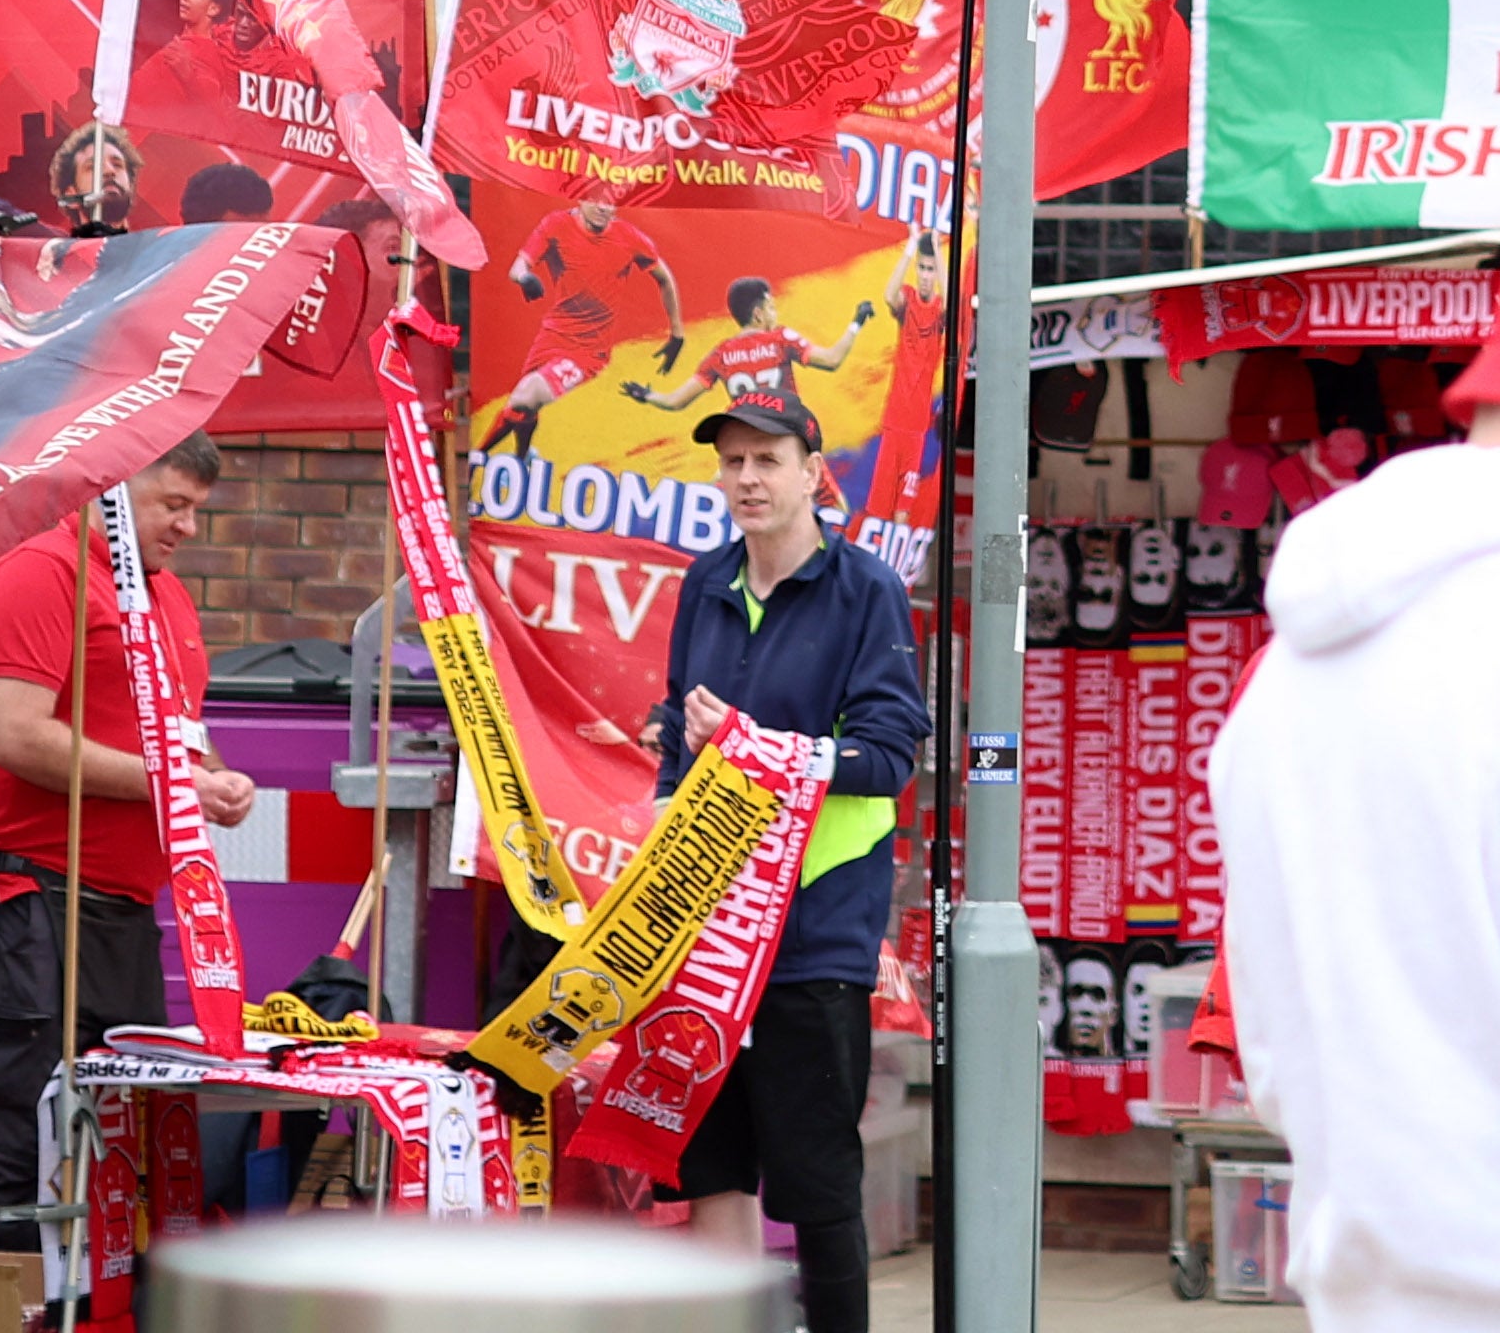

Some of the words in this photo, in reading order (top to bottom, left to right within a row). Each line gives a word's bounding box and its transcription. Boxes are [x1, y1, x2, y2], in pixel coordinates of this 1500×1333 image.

[644, 1, 725, 53] LIVERPOOL
[281, 124, 336, 159] PARIS
[504, 134, 580, 175] You'll
[587, 151, 670, 187] Never
[673, 158, 750, 188] Walk
[752, 161, 826, 195] Alone
[182, 254, 251, 342] AND
[241, 244, 267, 274] I
[1308, 281, 1496, 327] LIVERPOOL
[397, 512, 436, 589] SUNDAY
[433, 633, 458, 670] MAY
[449, 677, 476, 727] 2022
[422, 500, 462, 581] SUNDAY
[468, 629, 490, 669] MAY
[131, 649, 163, 774] SATURDAY
[1025, 649, 1065, 790] HARVEY
[1074, 655, 1110, 723] TRENT
[1137, 667, 1178, 774] LUIS
[979, 735, 1007, 748] PASSO
[646, 812, 688, 865] 2022
[689, 768, 716, 818] MAY
[1069, 731, 1110, 939] ALEXANDER-ARNOLD
[1133, 786, 1177, 899] DIAZ
[593, 782, 759, 987] WOLVERHAMPTON
[759, 814, 801, 940] SATURDAY
[1021, 796, 1064, 937] ELLIOTT
[1185, 793, 1226, 936] JOTA
[73, 1060, 140, 1081] PARIS
[602, 1086, 686, 1135] LIVERPOOL
